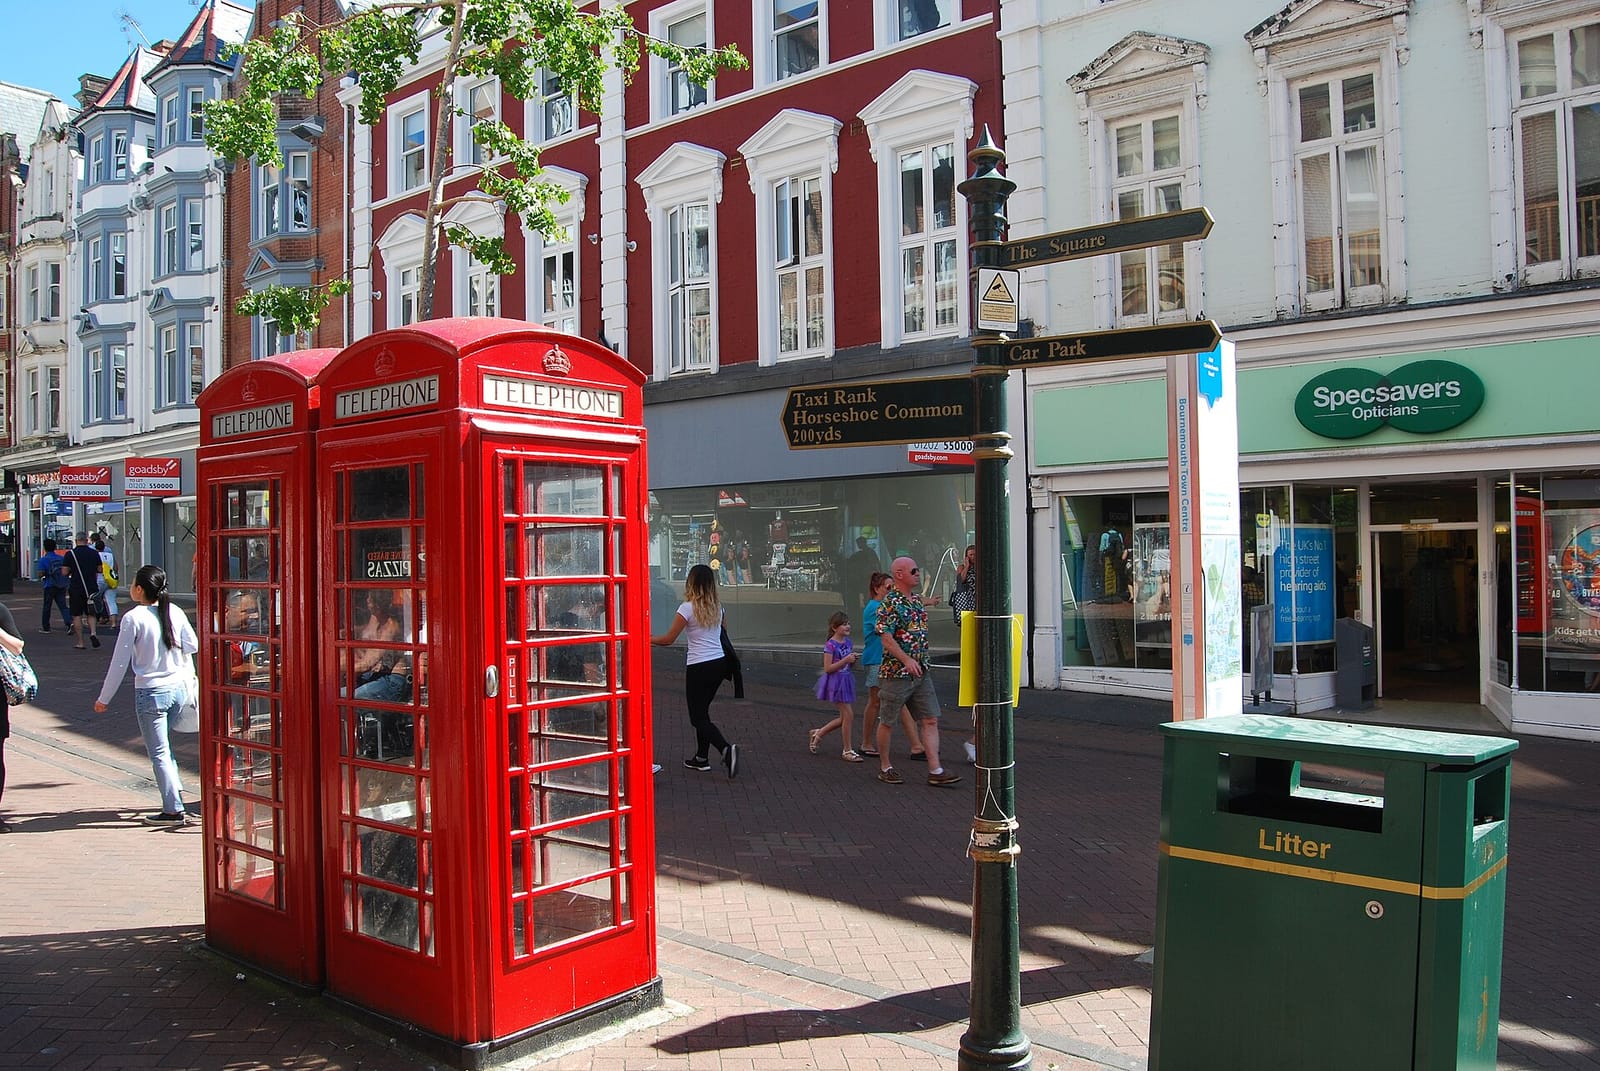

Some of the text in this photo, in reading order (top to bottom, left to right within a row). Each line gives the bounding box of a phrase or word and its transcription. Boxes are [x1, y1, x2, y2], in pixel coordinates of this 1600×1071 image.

[1008, 235, 1105, 261] The Square
[1009, 339, 1087, 361] Car Park
[340, 379, 438, 416] TELEPHONE
[489, 378, 617, 414] TELEPHONE
[793, 388, 877, 408] Taxi Rank
[1313, 380, 1460, 411] Specsavers
[216, 404, 292, 437] TELEPHONE
[793, 403, 963, 426] Horseshoe Common
[1352, 405, 1419, 421] Opticians
[793, 426, 842, 445] 200yds
[943, 440, 975, 451] 55000
[914, 453, 948, 462] goadsby.com
[1179, 398, 1190, 532] Bournemouth Town Centre
[62, 471, 99, 483] goadsby
[128, 464, 169, 476] goadsby
[1280, 580, 1313, 594] hering
[1554, 627, 1575, 636] Kids
[1576, 628, 1593, 638] get
[508, 657, 516, 698] PULL
[1259, 827, 1332, 859] Litter
